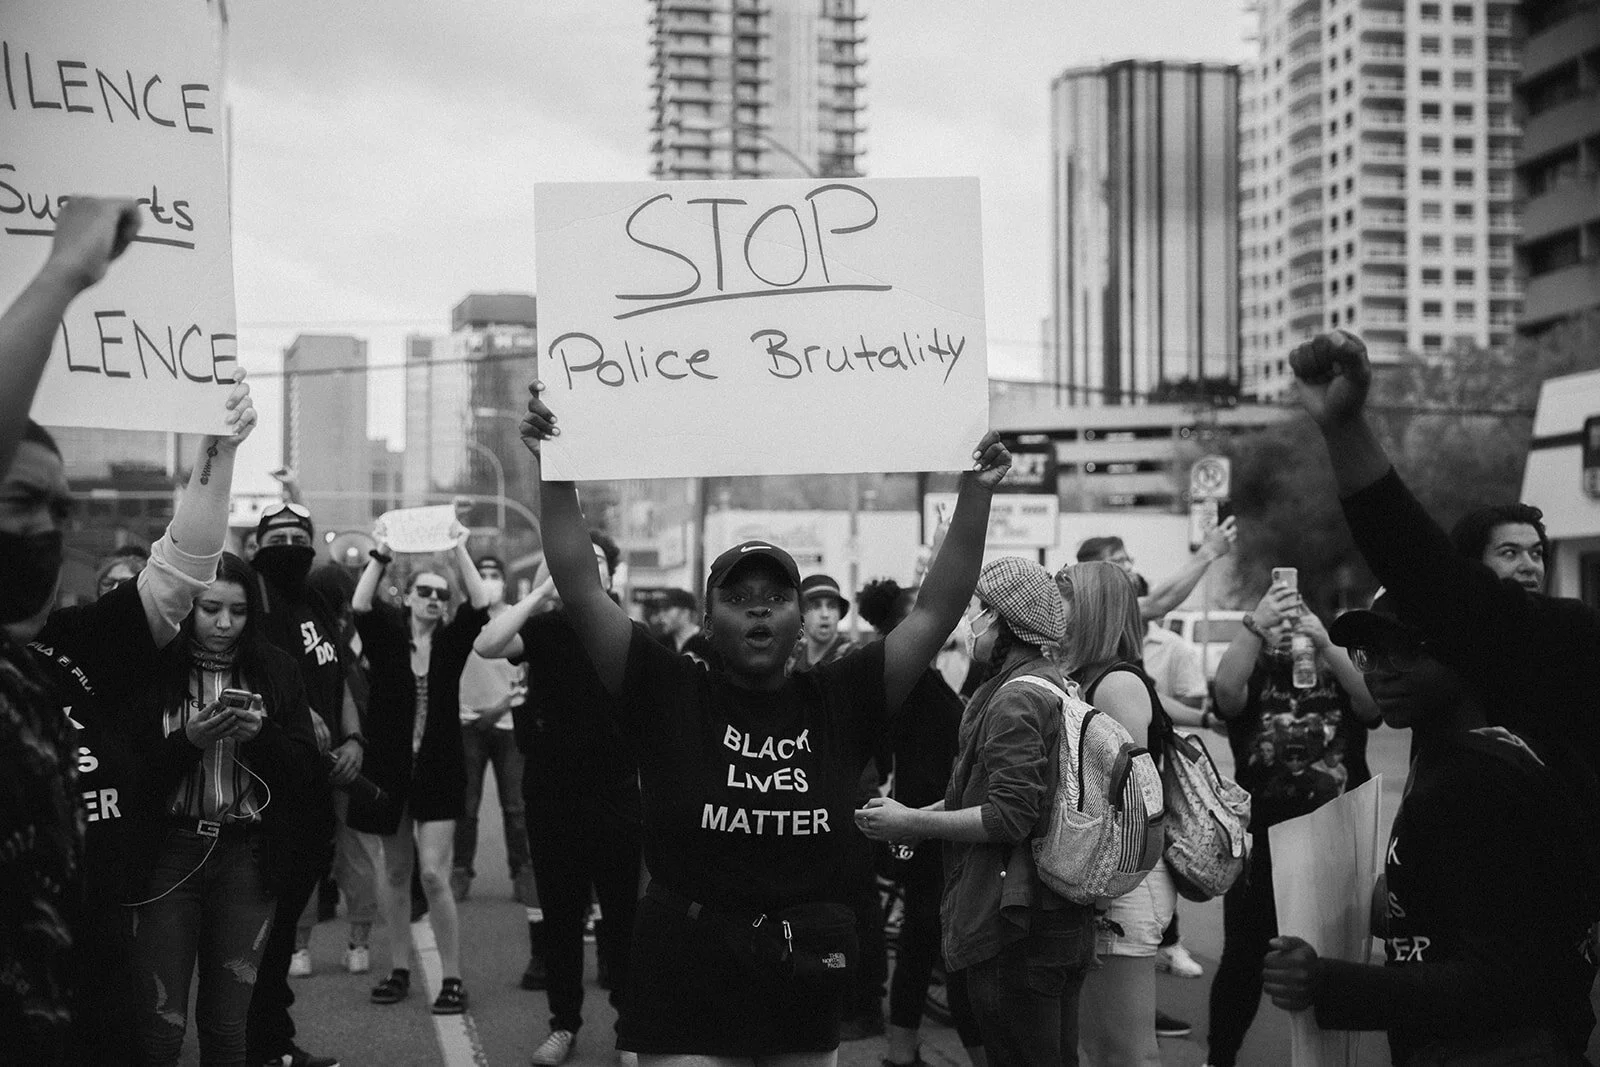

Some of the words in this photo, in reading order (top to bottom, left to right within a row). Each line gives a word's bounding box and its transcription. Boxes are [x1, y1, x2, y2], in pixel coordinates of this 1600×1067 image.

[615, 183, 878, 300] STOP
[548, 331, 718, 390] Police
[750, 328, 966, 385] Brutality
[723, 724, 812, 761] BLACK
[727, 764, 809, 792] LIVES
[701, 803, 831, 835] MATTER
